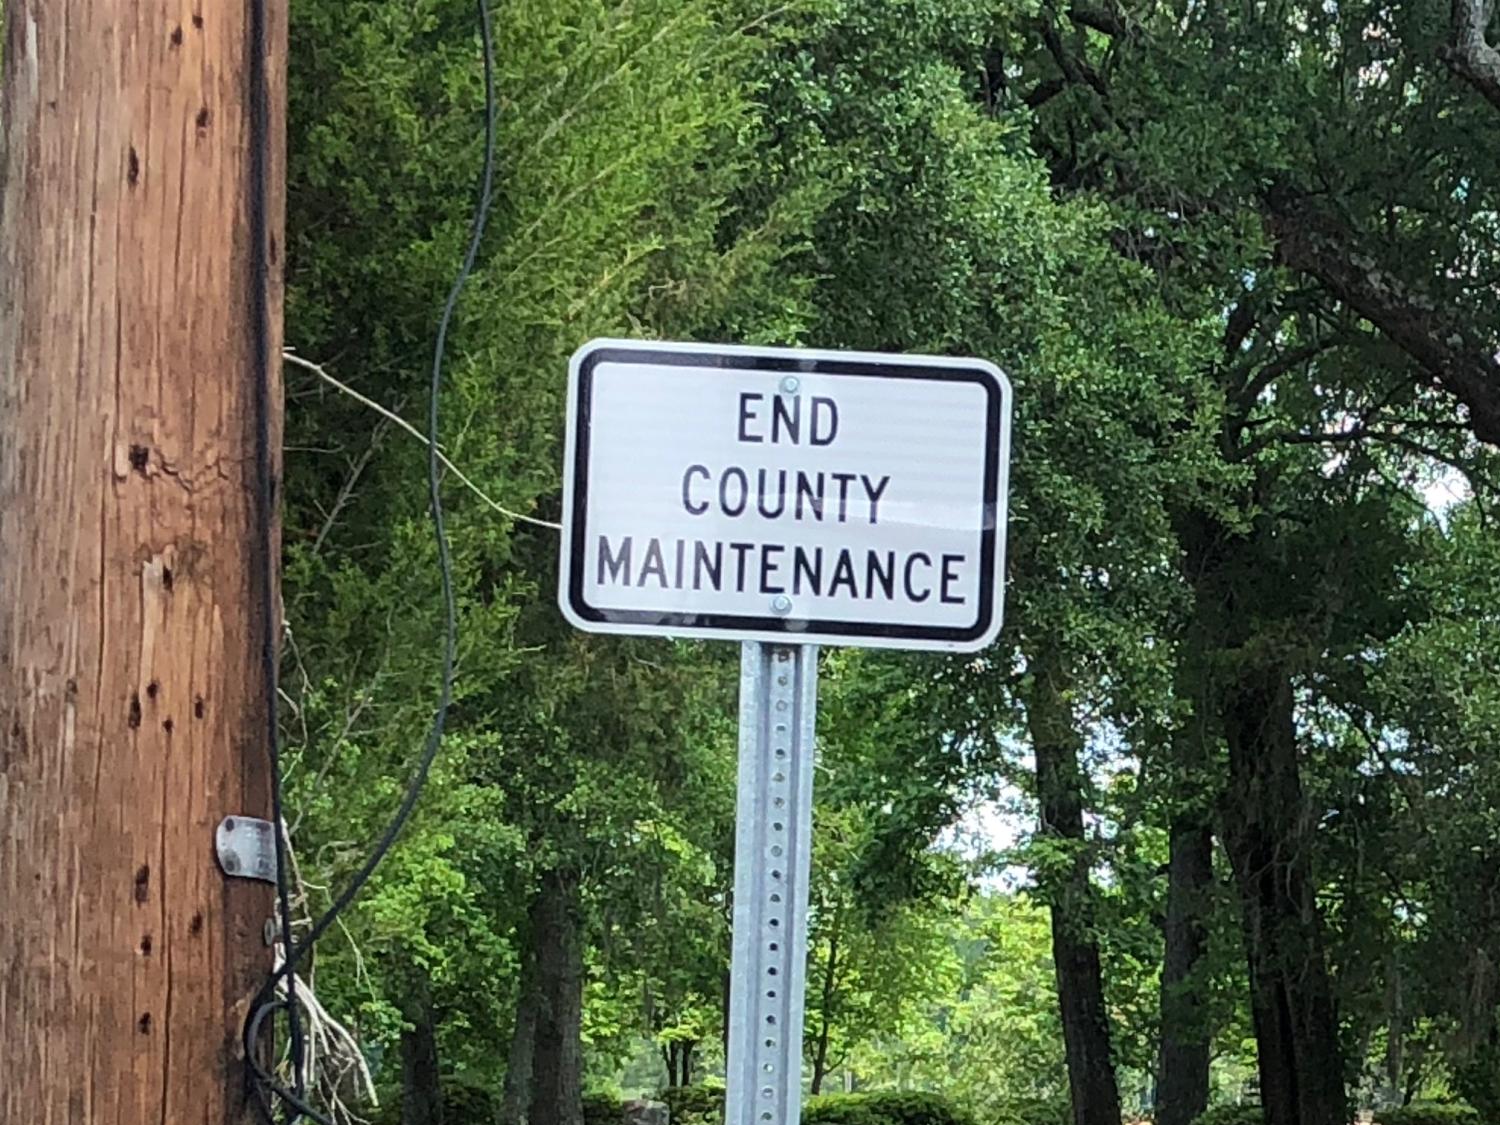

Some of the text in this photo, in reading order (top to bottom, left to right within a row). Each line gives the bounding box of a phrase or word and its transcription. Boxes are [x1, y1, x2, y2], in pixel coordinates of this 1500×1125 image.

[737, 392, 839, 446] END
[682, 464, 891, 525] COUNTY
[596, 535, 967, 604] MAINTENANCE
